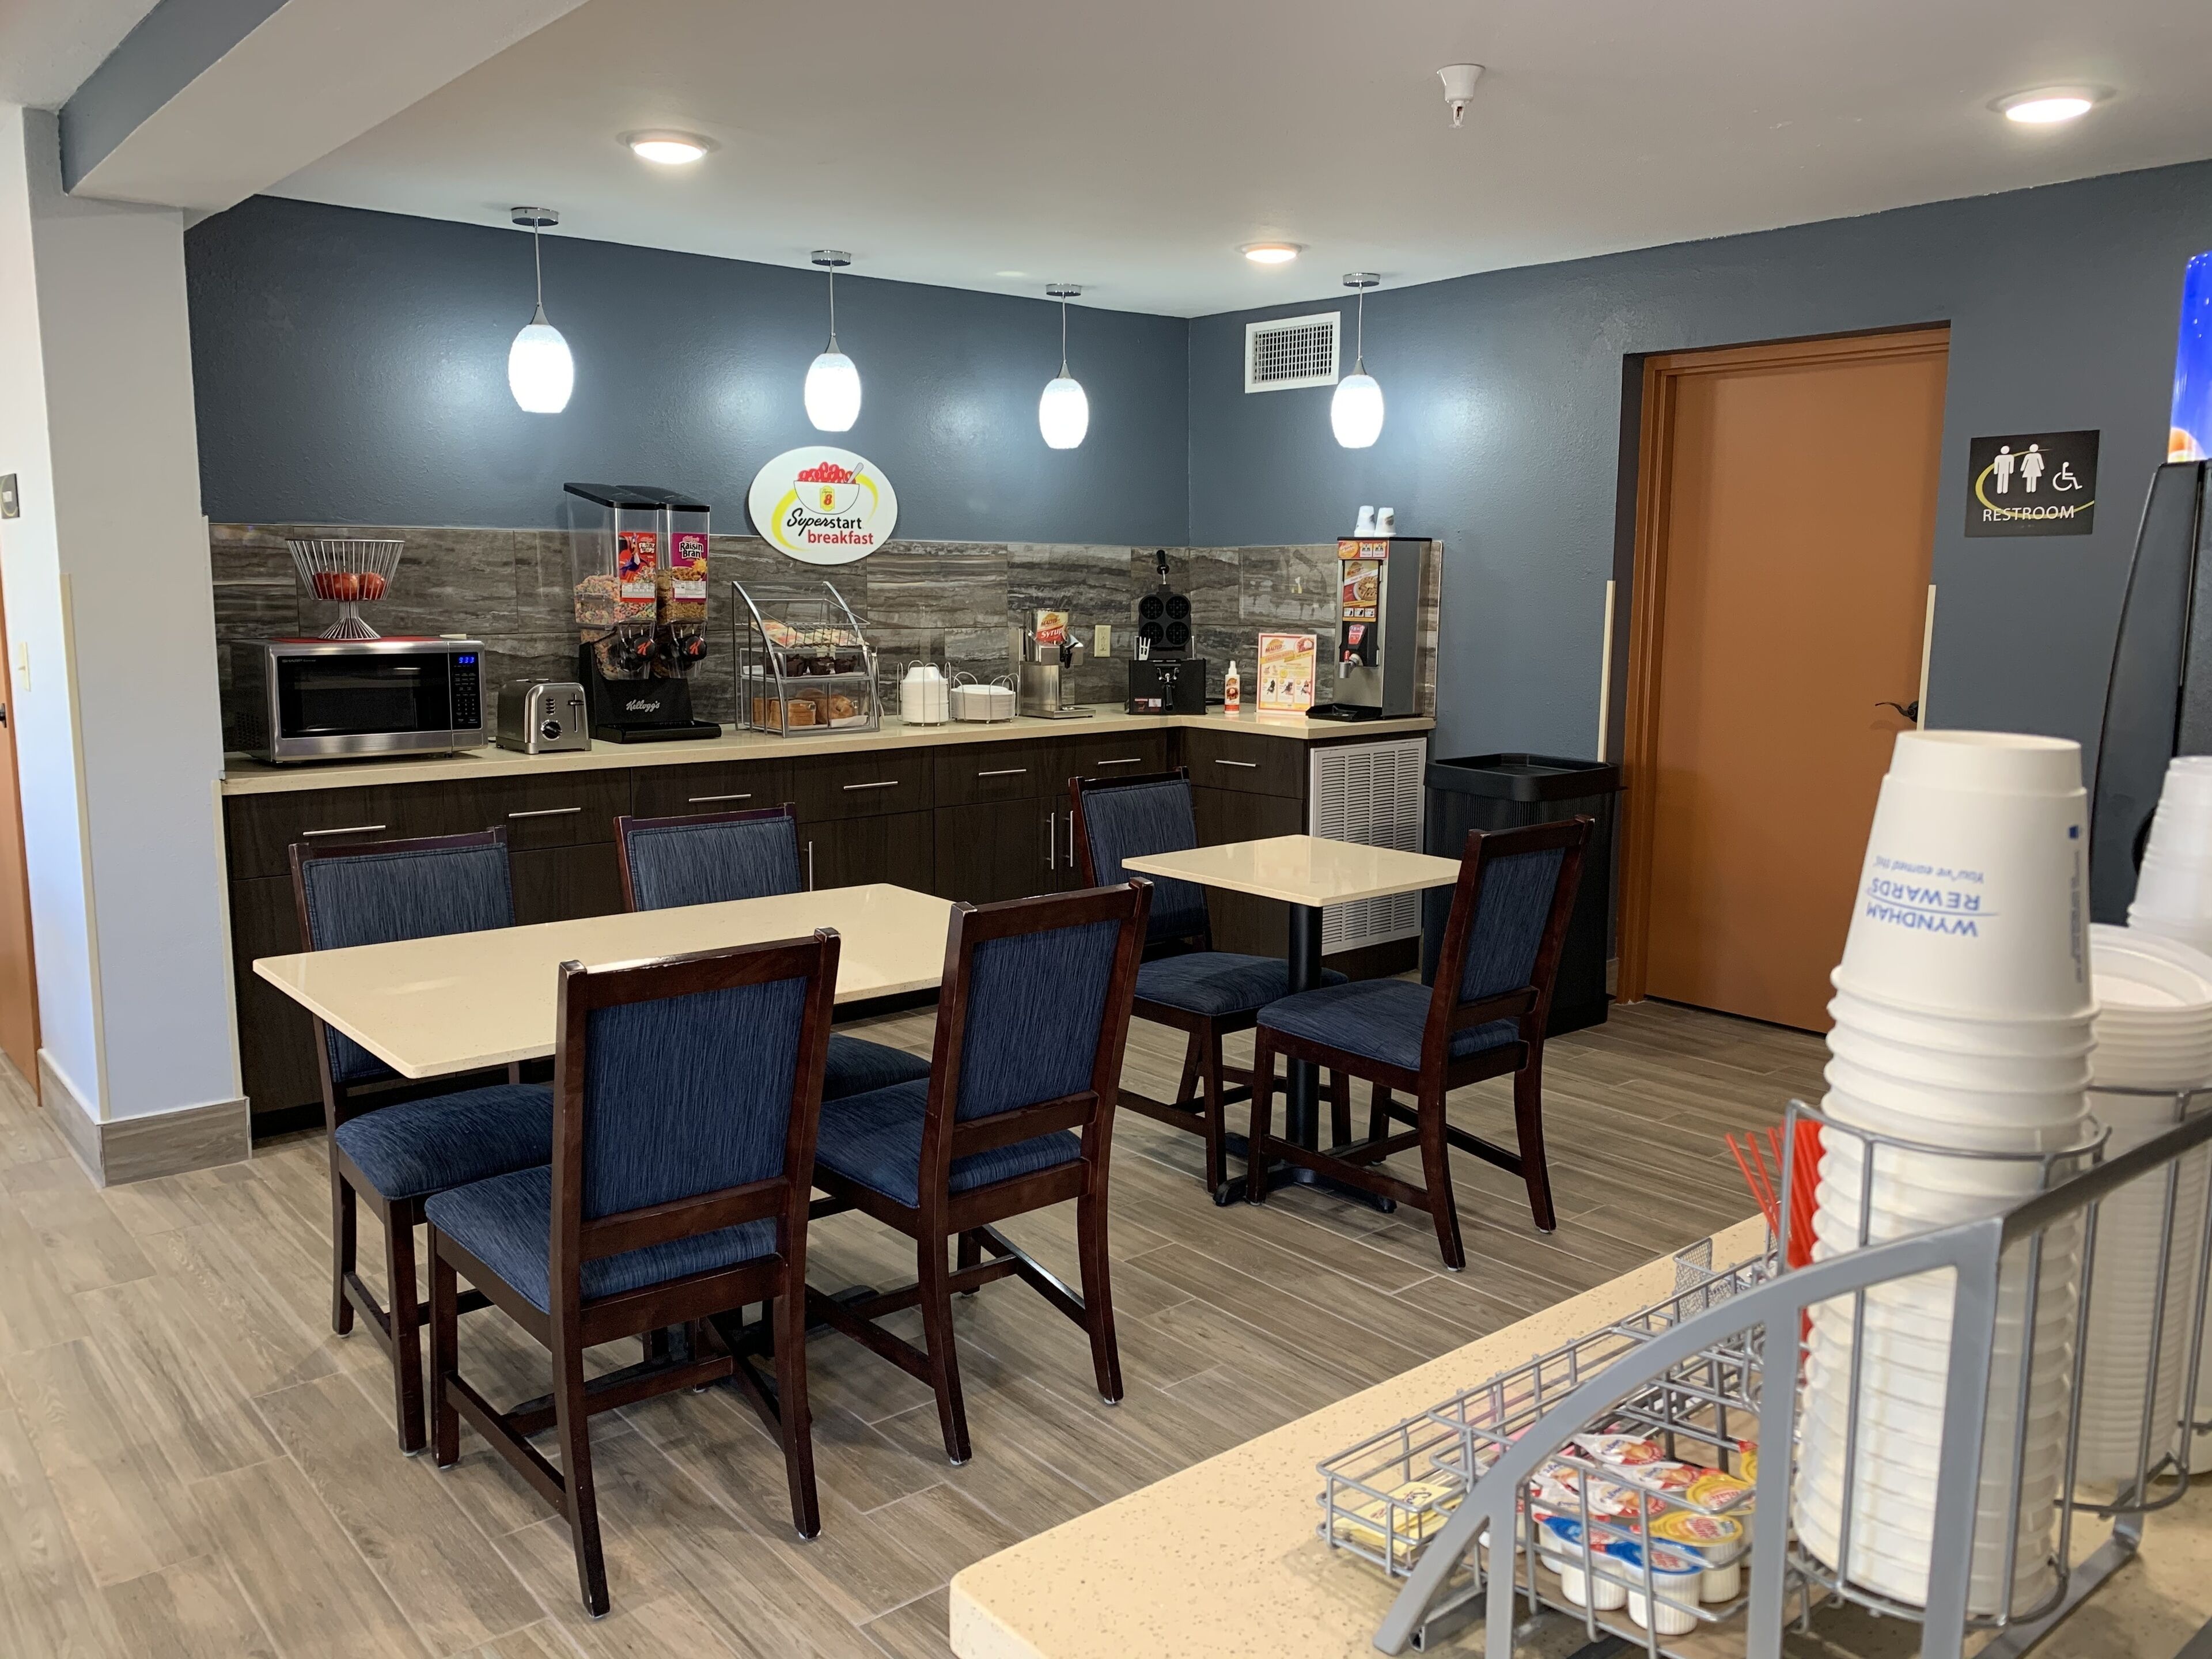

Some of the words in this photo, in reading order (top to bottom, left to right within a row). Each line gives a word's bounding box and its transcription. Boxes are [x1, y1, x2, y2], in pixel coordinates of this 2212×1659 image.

[824, 494, 832, 505] 8
[1983, 505, 2074, 522] RESTROOM
[787, 507, 862, 536] Superstart
[808, 529, 874, 545] breakfast
[680, 541, 703, 552] Raisin
[682, 550, 702, 558] Bran
[1041, 627, 1063, 639] Syrup
[626, 699, 661, 713] Kellogg's
[1871, 877, 1981, 911] REWARDS
[1866, 902, 1979, 938] WYNDHAM
